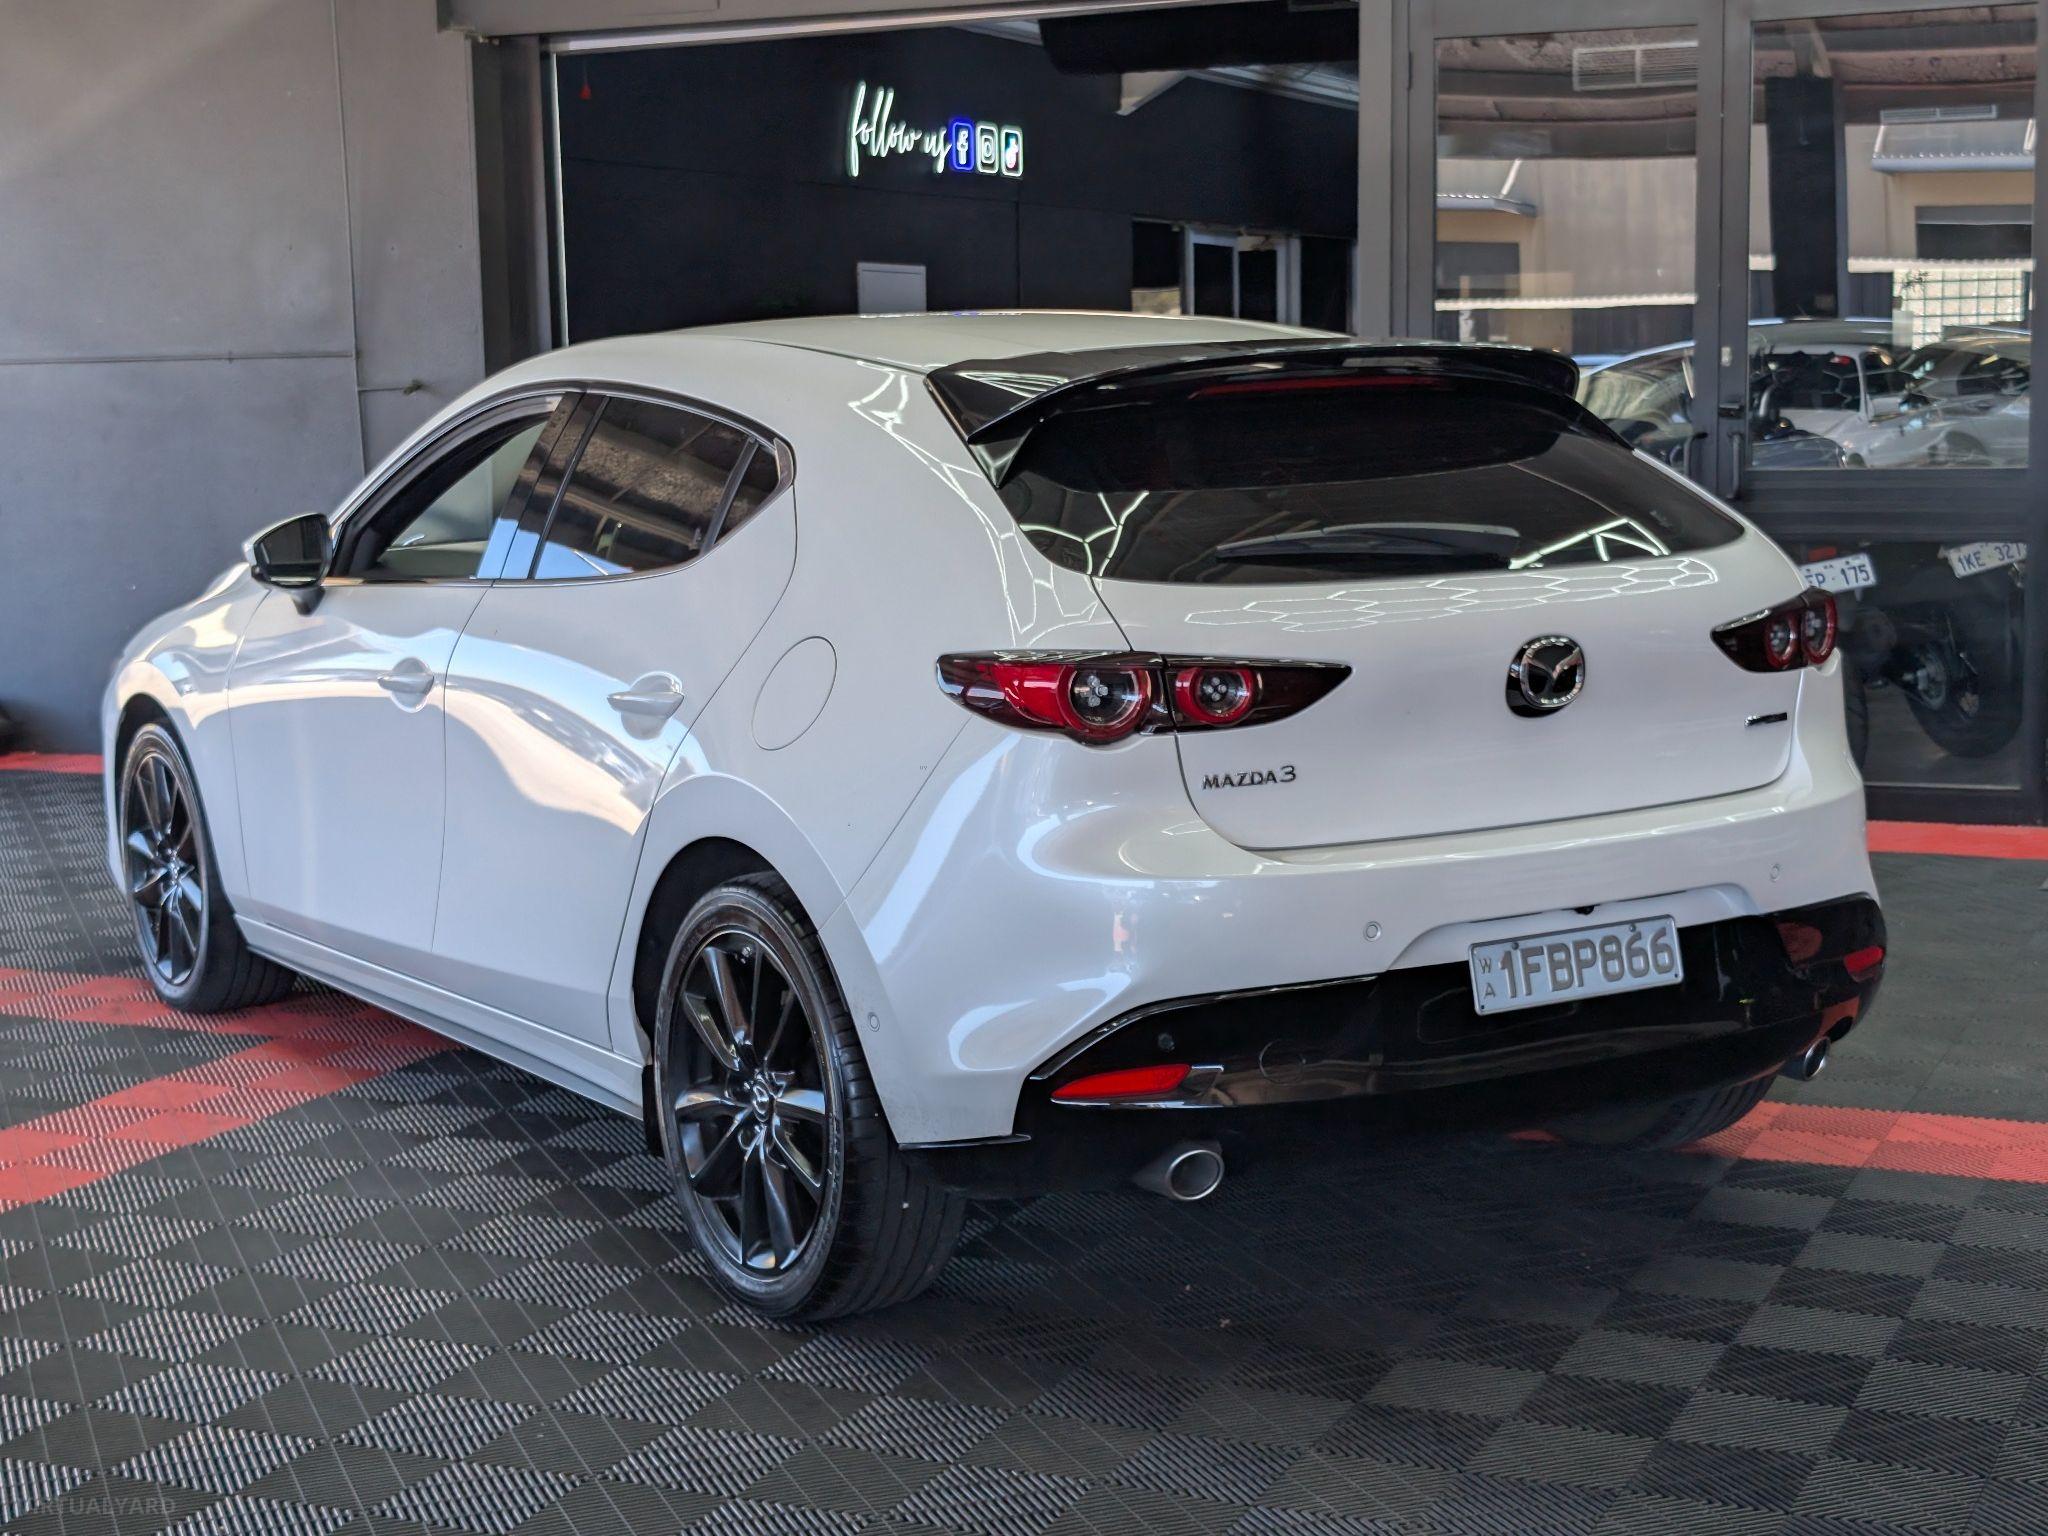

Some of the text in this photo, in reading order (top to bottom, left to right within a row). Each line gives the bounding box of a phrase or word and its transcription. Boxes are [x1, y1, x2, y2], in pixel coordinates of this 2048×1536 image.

[848, 81, 922, 177] follow
[922, 125, 951, 174] us
[1203, 765, 1296, 789] MAZDA3
[1499, 927, 1675, 999] 1FBP866
